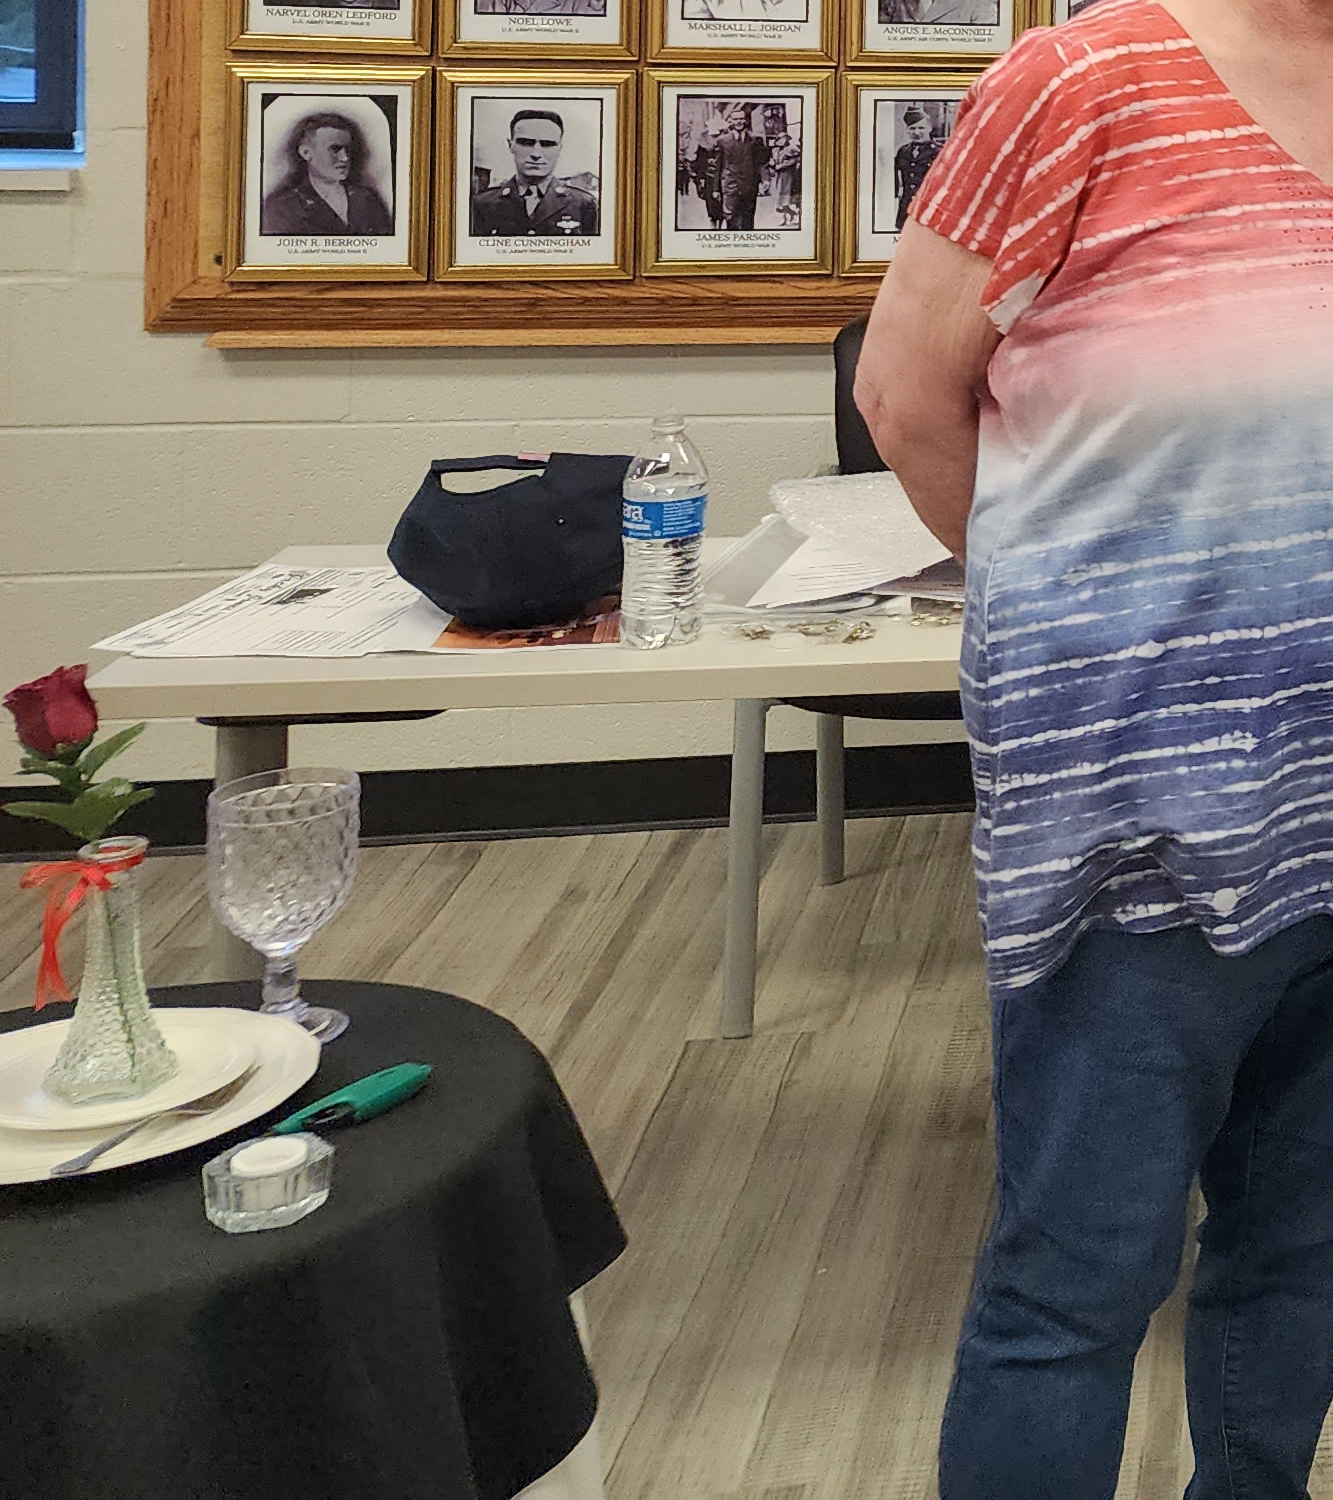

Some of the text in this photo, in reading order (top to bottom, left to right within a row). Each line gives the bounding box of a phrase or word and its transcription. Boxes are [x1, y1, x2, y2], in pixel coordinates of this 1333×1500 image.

[266, 8, 397, 21] NARVEL OREN LEDFORD
[508, 17, 573, 26] NOEL LOWE
[687, 22, 745, 32] MARSHALL
[759, 24, 801, 33] JORDAN
[883, 26, 920, 34] ANGUS
[933, 27, 994, 36] McCONNELL
[696, 233, 781, 242] JAMES PARSONS
[277, 238, 378, 247] JOHN R. BERRONG
[478, 238, 591, 247] CLINE CUNNINGHAM
